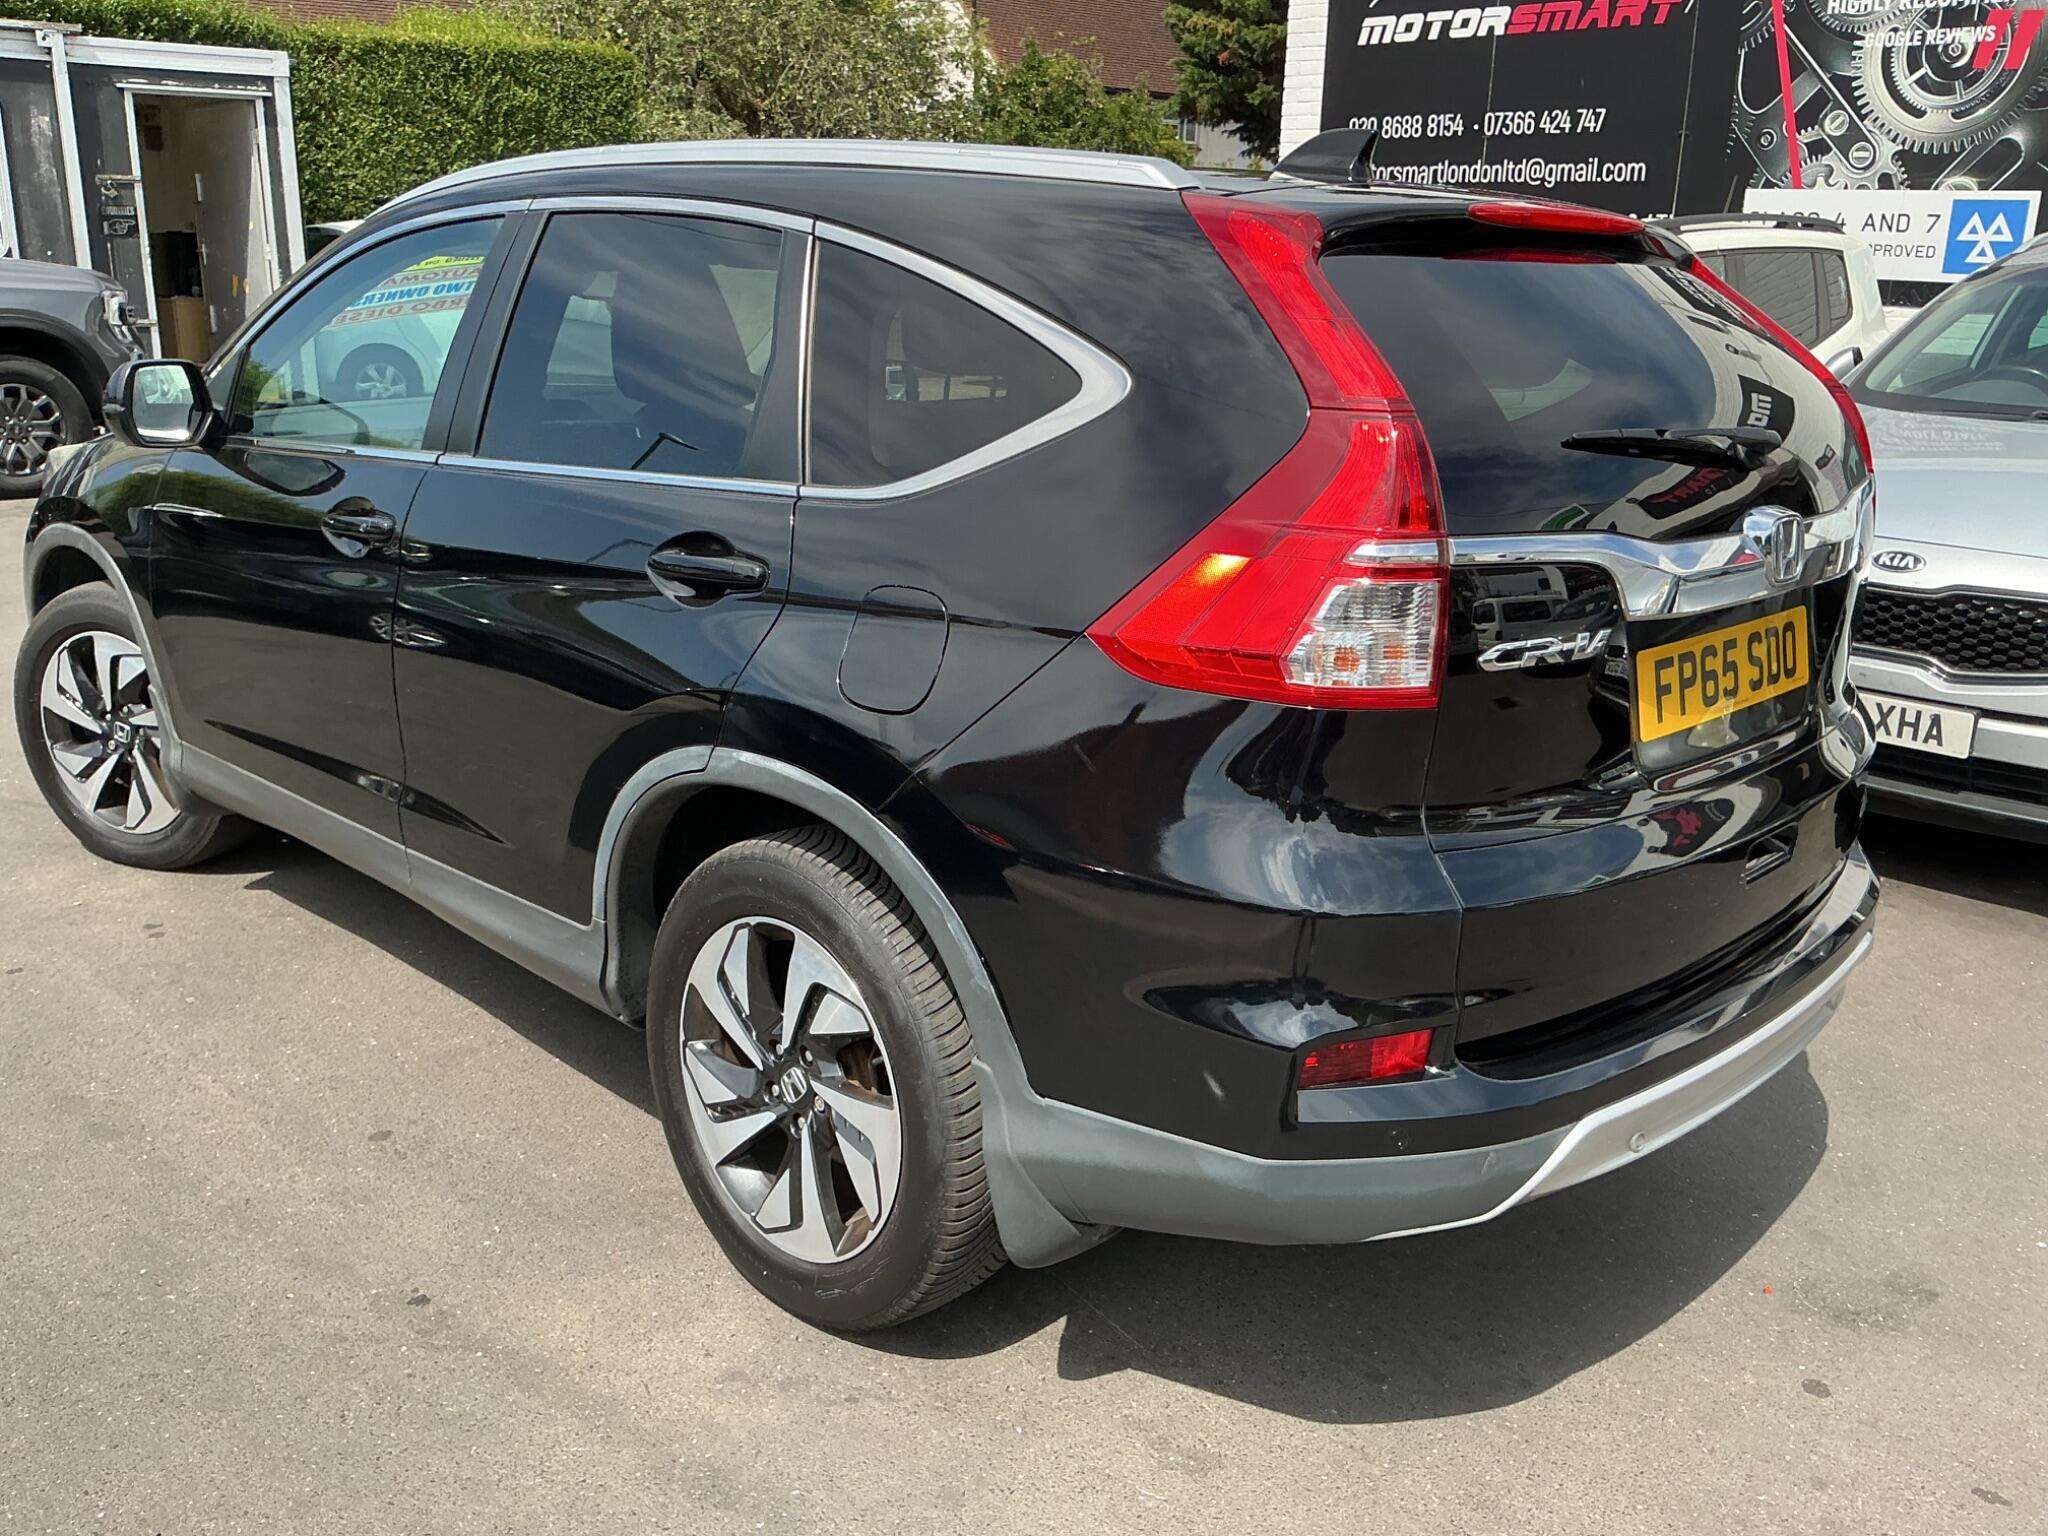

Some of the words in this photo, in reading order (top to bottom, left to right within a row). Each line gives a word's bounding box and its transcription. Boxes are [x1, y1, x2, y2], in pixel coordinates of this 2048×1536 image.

[1865, 30, 1922, 48] GOOGLE
[1926, 25, 1997, 46] REVIEWS
[1381, 114, 1423, 139] 8688
[1426, 113, 1465, 138] 8154
[1483, 110, 1536, 136] 07366
[1539, 109, 1572, 134] 424
[1576, 108, 1607, 133] 747
[1371, 157, 1647, 188] orsmartlondonltd@gmail.com
[1861, 213, 1911, 233] AND
[1926, 213, 1941, 233] 7
[1869, 243, 1936, 259] PROVED
[1878, 551, 1916, 570] KIA
[1653, 636, 1739, 725] FP65
[1746, 620, 1798, 692] SDO
[1874, 702, 1944, 747] XHA
